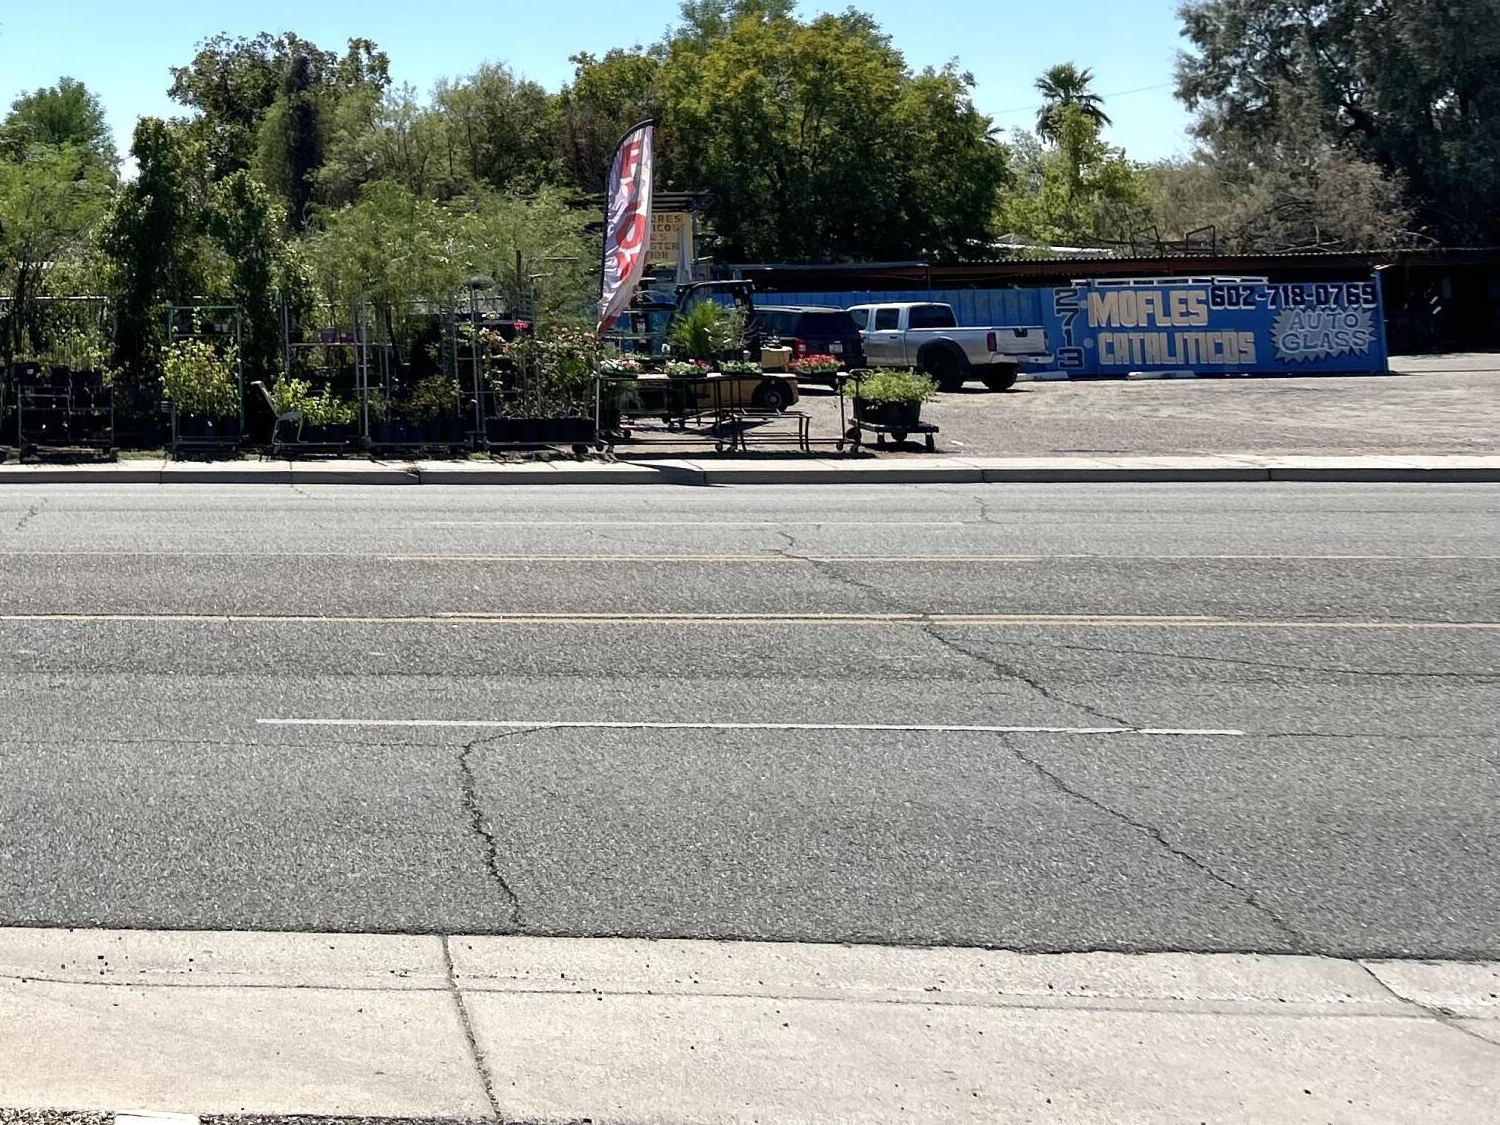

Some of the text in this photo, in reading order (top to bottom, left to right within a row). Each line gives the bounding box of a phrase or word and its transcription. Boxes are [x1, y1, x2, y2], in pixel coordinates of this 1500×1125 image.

[1088, 290, 1209, 327] MOFLES
[1210, 285, 1377, 309] 602-718-0769
[1288, 311, 1359, 329] AUTO
[1099, 332, 1256, 364] CATALITICOS
[1280, 330, 1366, 353] GLASS
